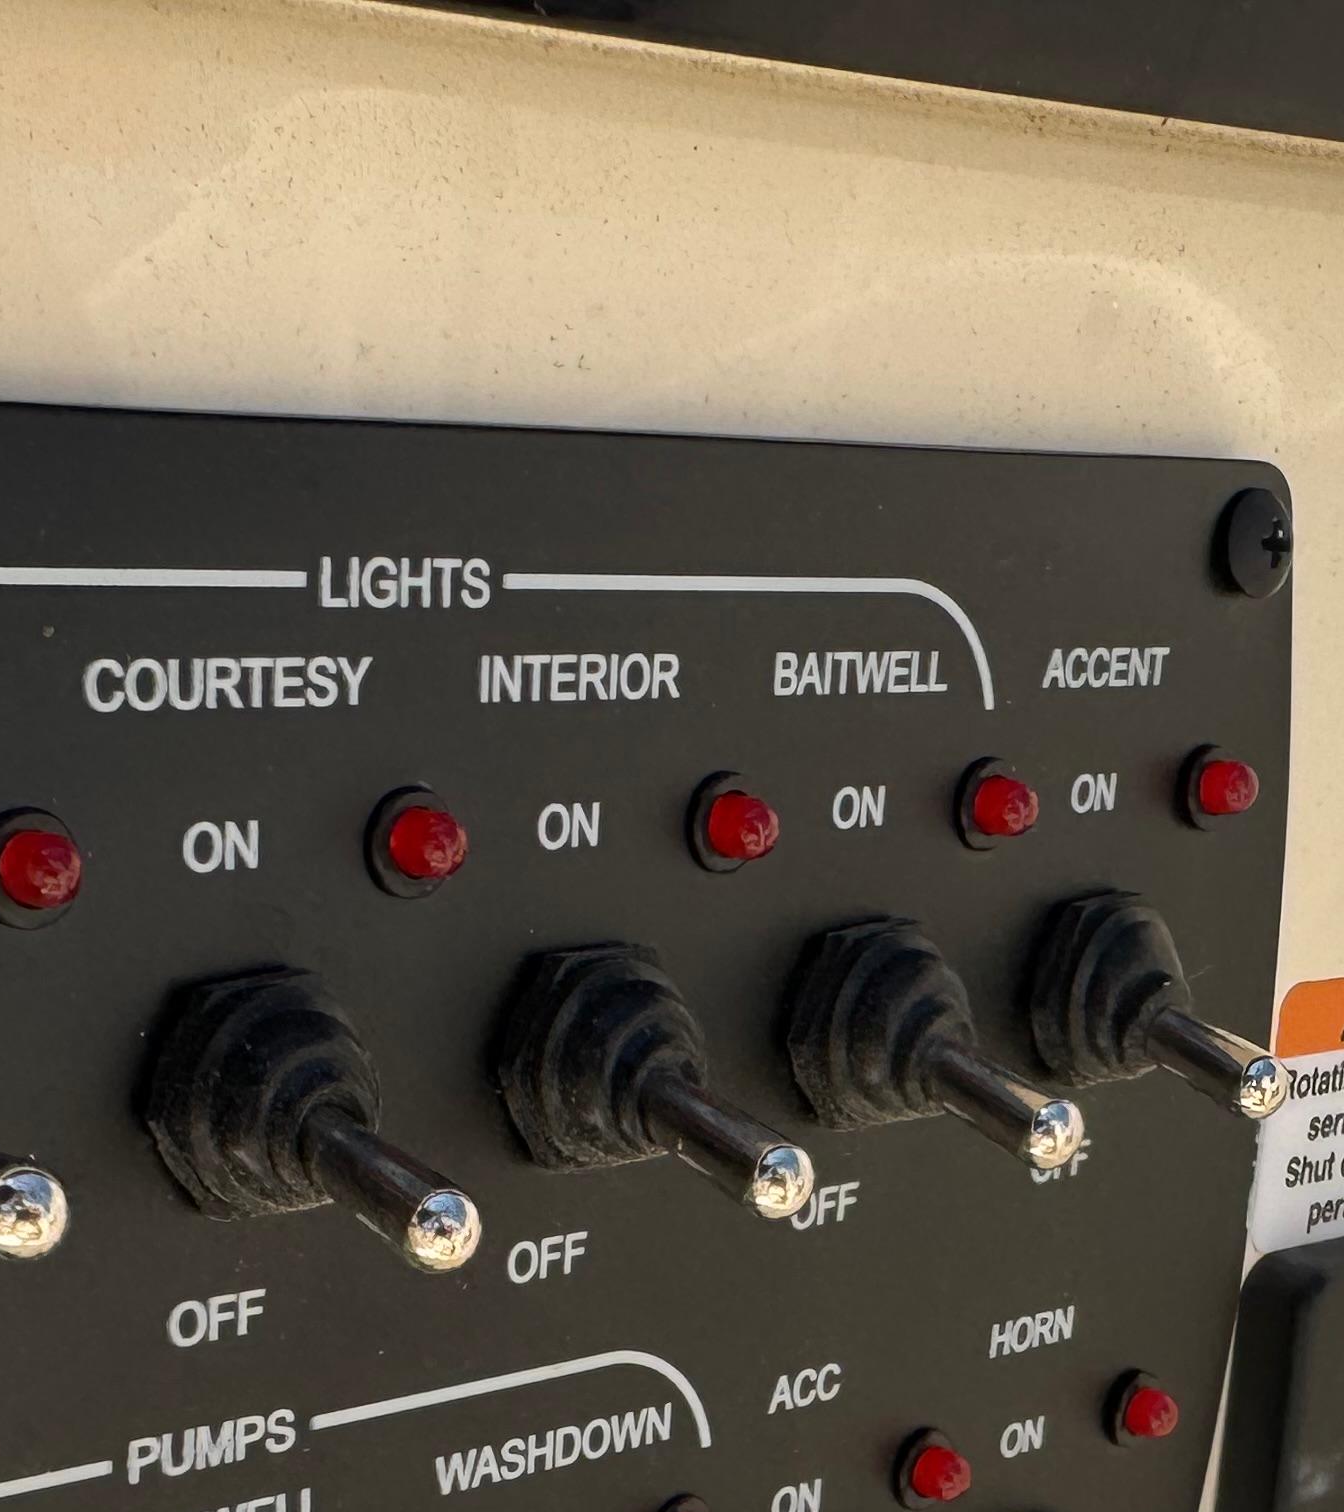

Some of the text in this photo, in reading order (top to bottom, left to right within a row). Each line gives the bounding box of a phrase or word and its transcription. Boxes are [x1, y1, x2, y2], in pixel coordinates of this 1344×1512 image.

[320, 556, 491, 609] LIGHTS
[83, 655, 374, 713] COURTESY
[479, 652, 681, 704] INTERIOR
[773, 650, 948, 696] BAITWELL
[1042, 646, 1171, 689] ACCENT
[832, 785, 886, 830] ON
[1070, 772, 1118, 814] ON
[182, 819, 259, 874] ON
[537, 801, 601, 851] ON
[1285, 1151, 1336, 1188] Shut
[507, 1230, 589, 1284] OFF
[168, 1288, 267, 1348] OFF
[989, 1304, 1076, 1359] HORN
[767, 1362, 842, 1415] ACC
[126, 1408, 297, 1485] PUMPS
[435, 1402, 673, 1496] WASHDOWN
[999, 1415, 1046, 1459] ON
